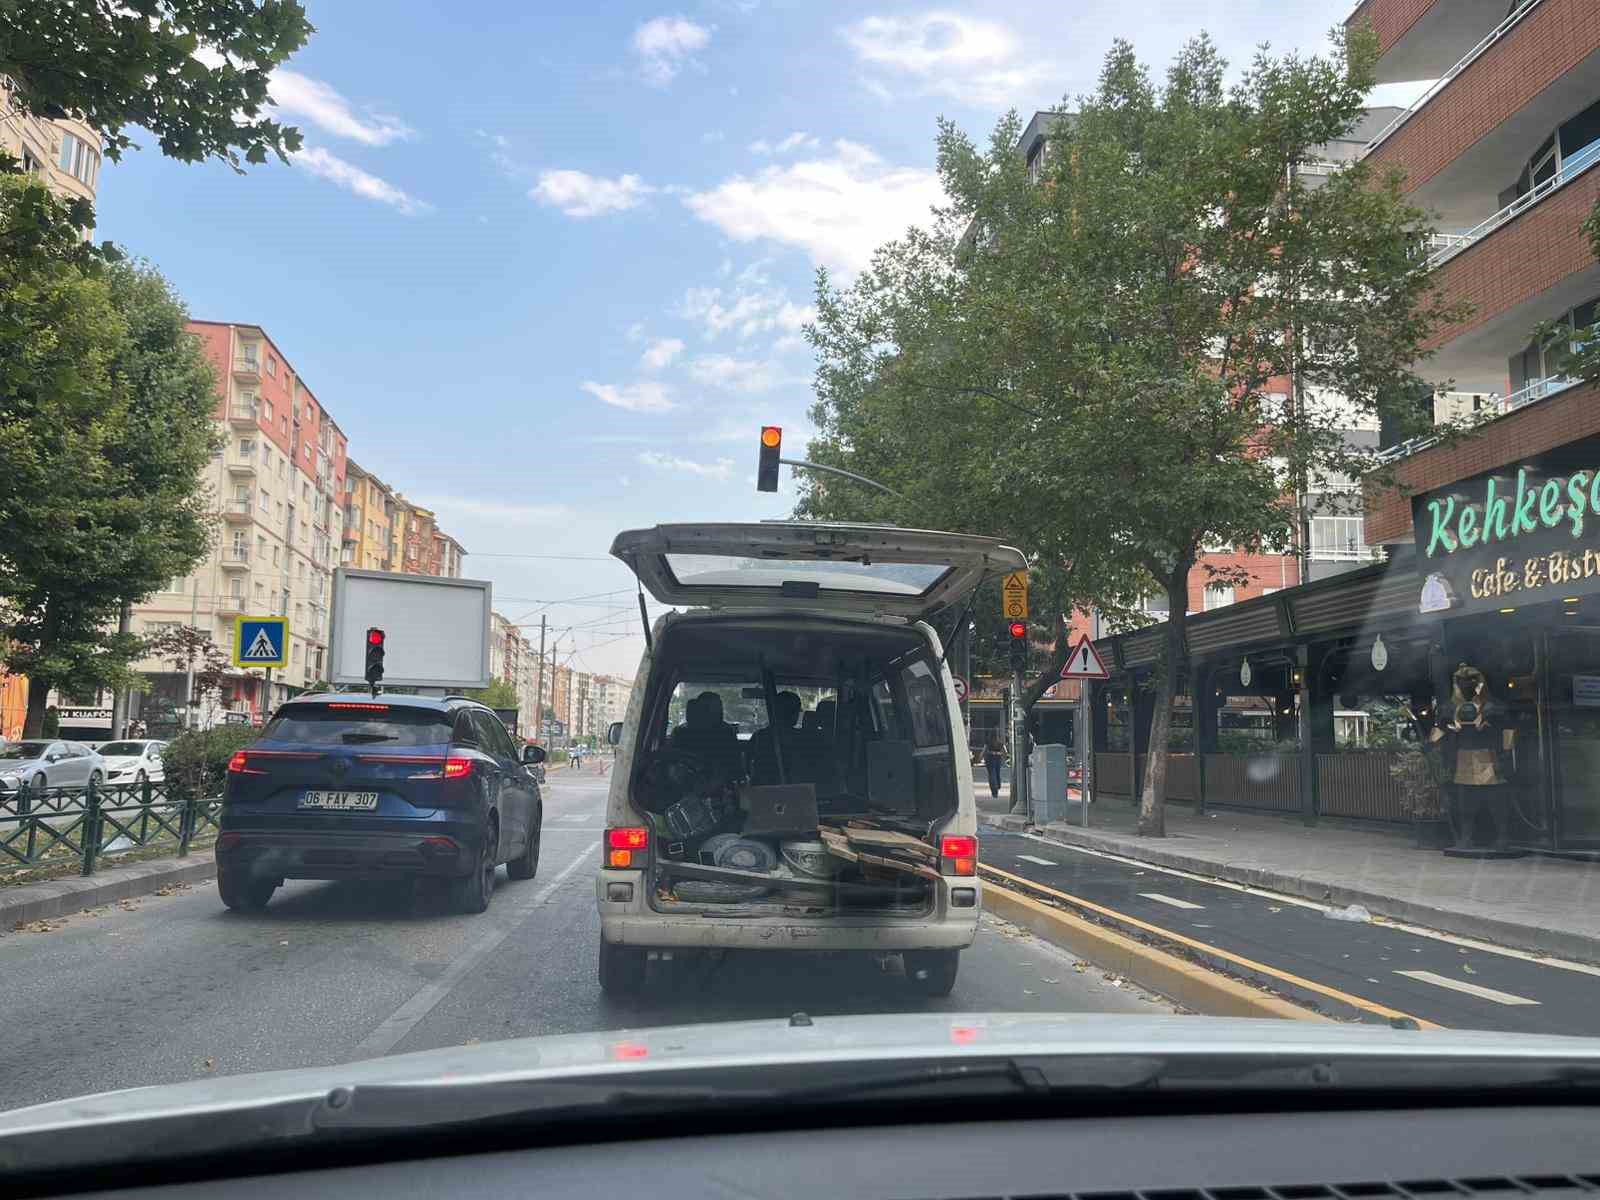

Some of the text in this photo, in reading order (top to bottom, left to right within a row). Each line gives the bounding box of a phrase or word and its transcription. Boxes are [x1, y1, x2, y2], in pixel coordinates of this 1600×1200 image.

[1524, 558, 1541, 588] &
[306, 792, 320, 804] 06
[355, 793, 376, 806] 307
